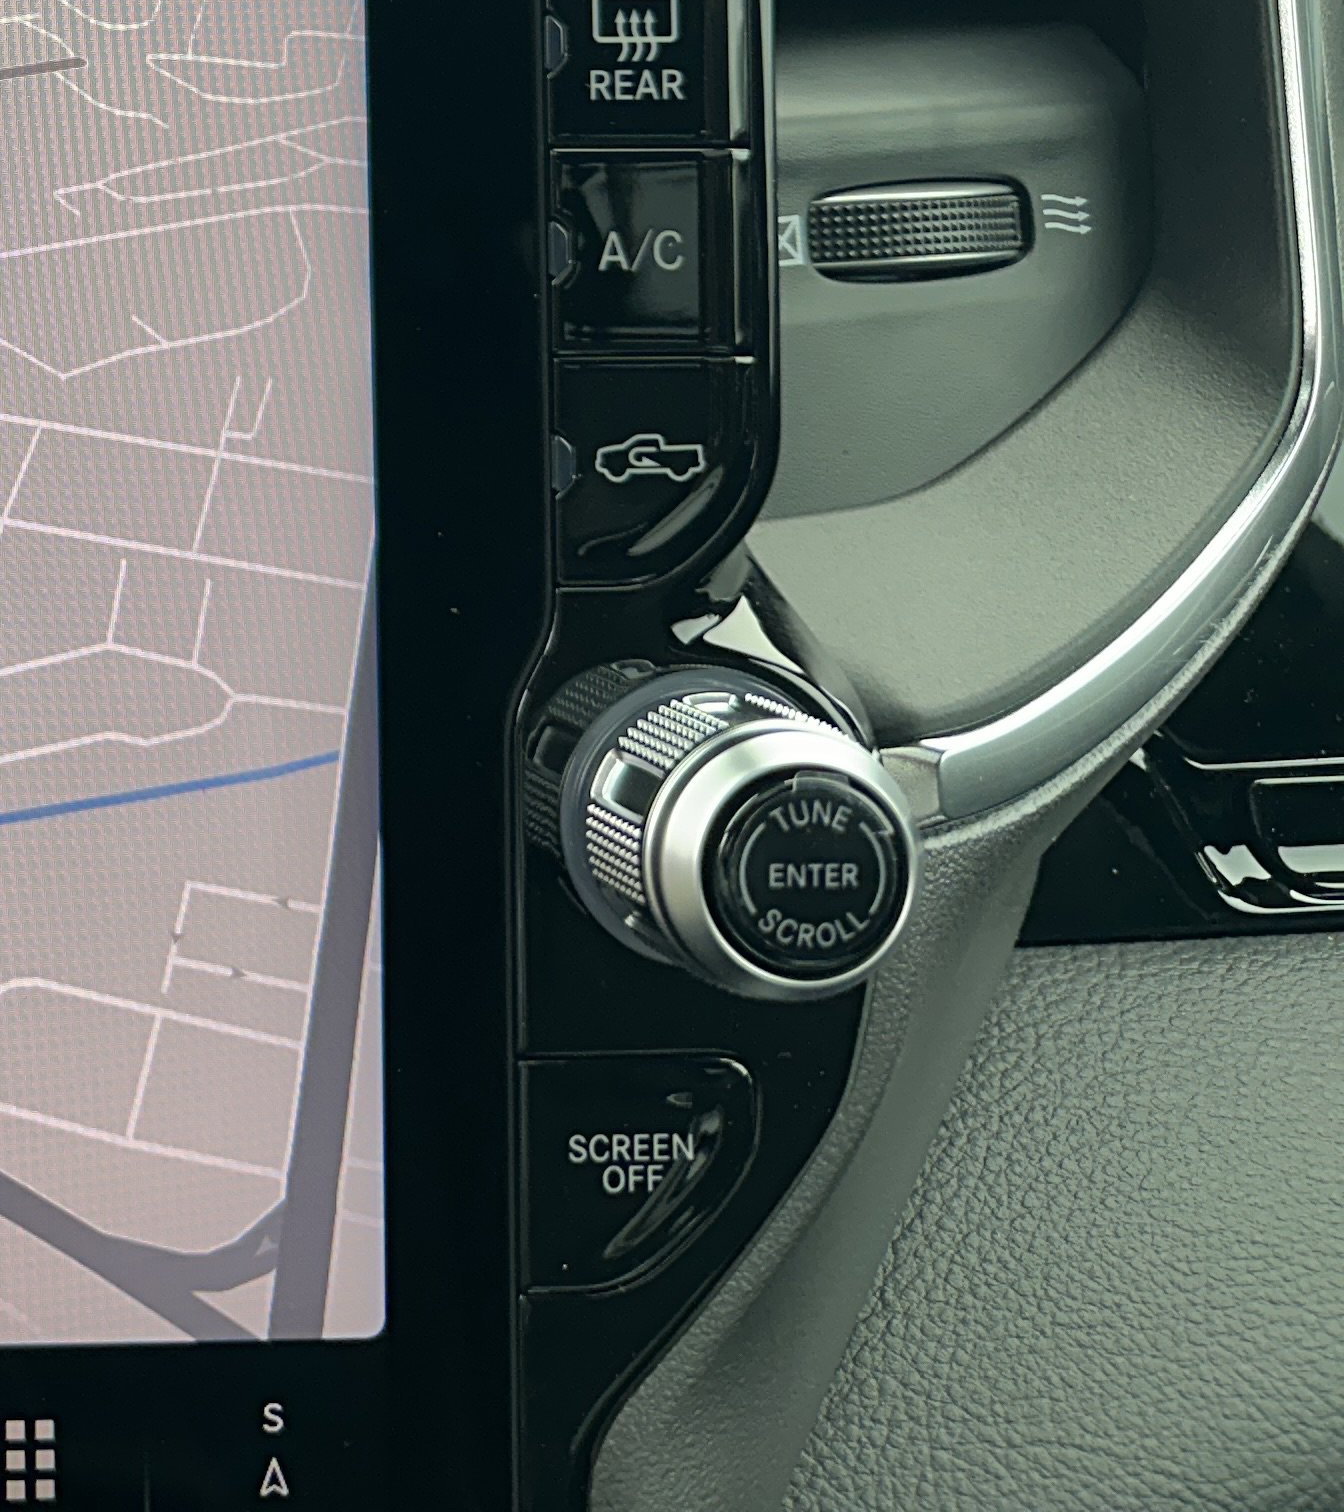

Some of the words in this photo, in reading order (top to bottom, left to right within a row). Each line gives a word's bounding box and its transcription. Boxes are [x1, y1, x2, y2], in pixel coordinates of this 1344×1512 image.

[589, 69, 685, 101] REAR
[598, 228, 684, 271] A/C
[769, 799, 852, 834] TUNE
[769, 863, 859, 888] ENTER
[757, 908, 871, 950] SCROLL
[568, 1133, 695, 1163] SCREEN
[602, 1165, 664, 1194] OFF
[263, 1402, 284, 1433] S
